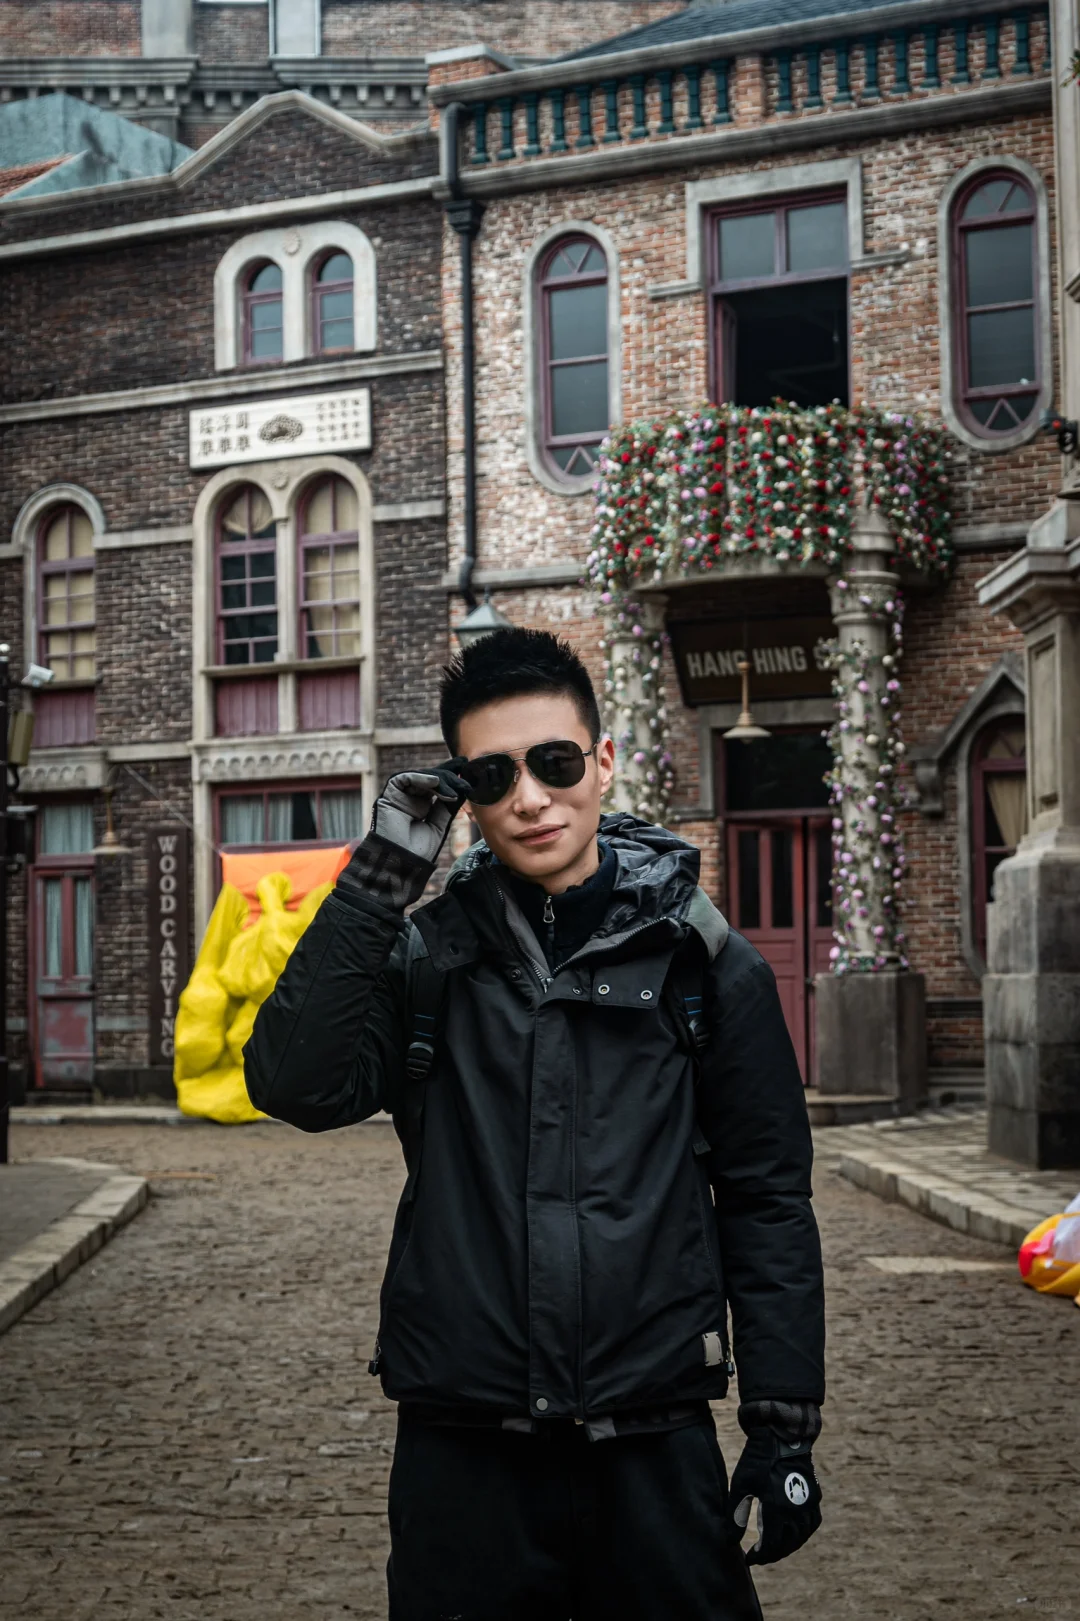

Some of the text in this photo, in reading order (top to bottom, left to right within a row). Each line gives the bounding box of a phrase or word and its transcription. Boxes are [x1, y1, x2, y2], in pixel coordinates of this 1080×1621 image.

[752, 646, 808, 675] HING
[157, 835, 178, 1057] WOOD CARVING
